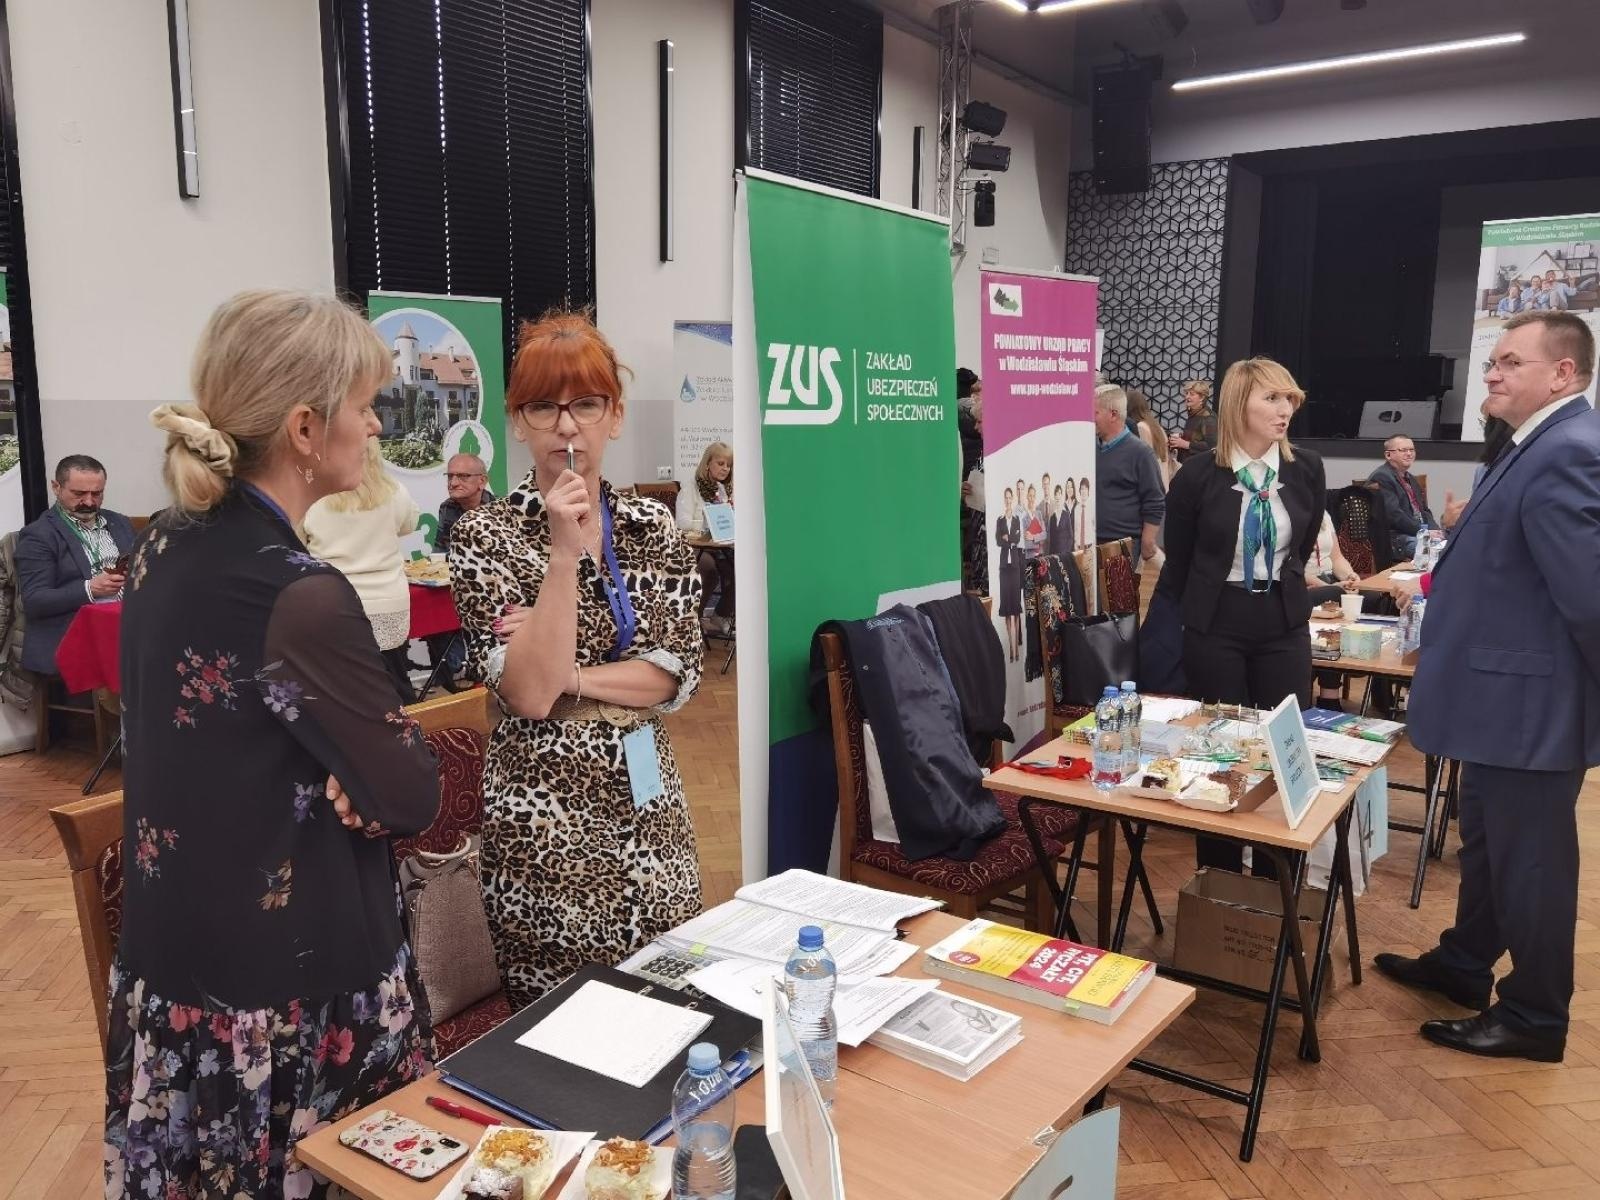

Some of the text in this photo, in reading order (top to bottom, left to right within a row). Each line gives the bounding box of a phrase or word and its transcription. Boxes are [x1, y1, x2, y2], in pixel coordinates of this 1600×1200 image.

[993, 333, 1091, 355] POWIATOWY URZĄD PRACY
[866, 351, 912, 371] ZAKŁAD
[763, 343, 843, 425] ZUS
[867, 377, 938, 397] UBEZPIECZEŃ
[867, 404, 944, 421] SPOŁECZNYCH
